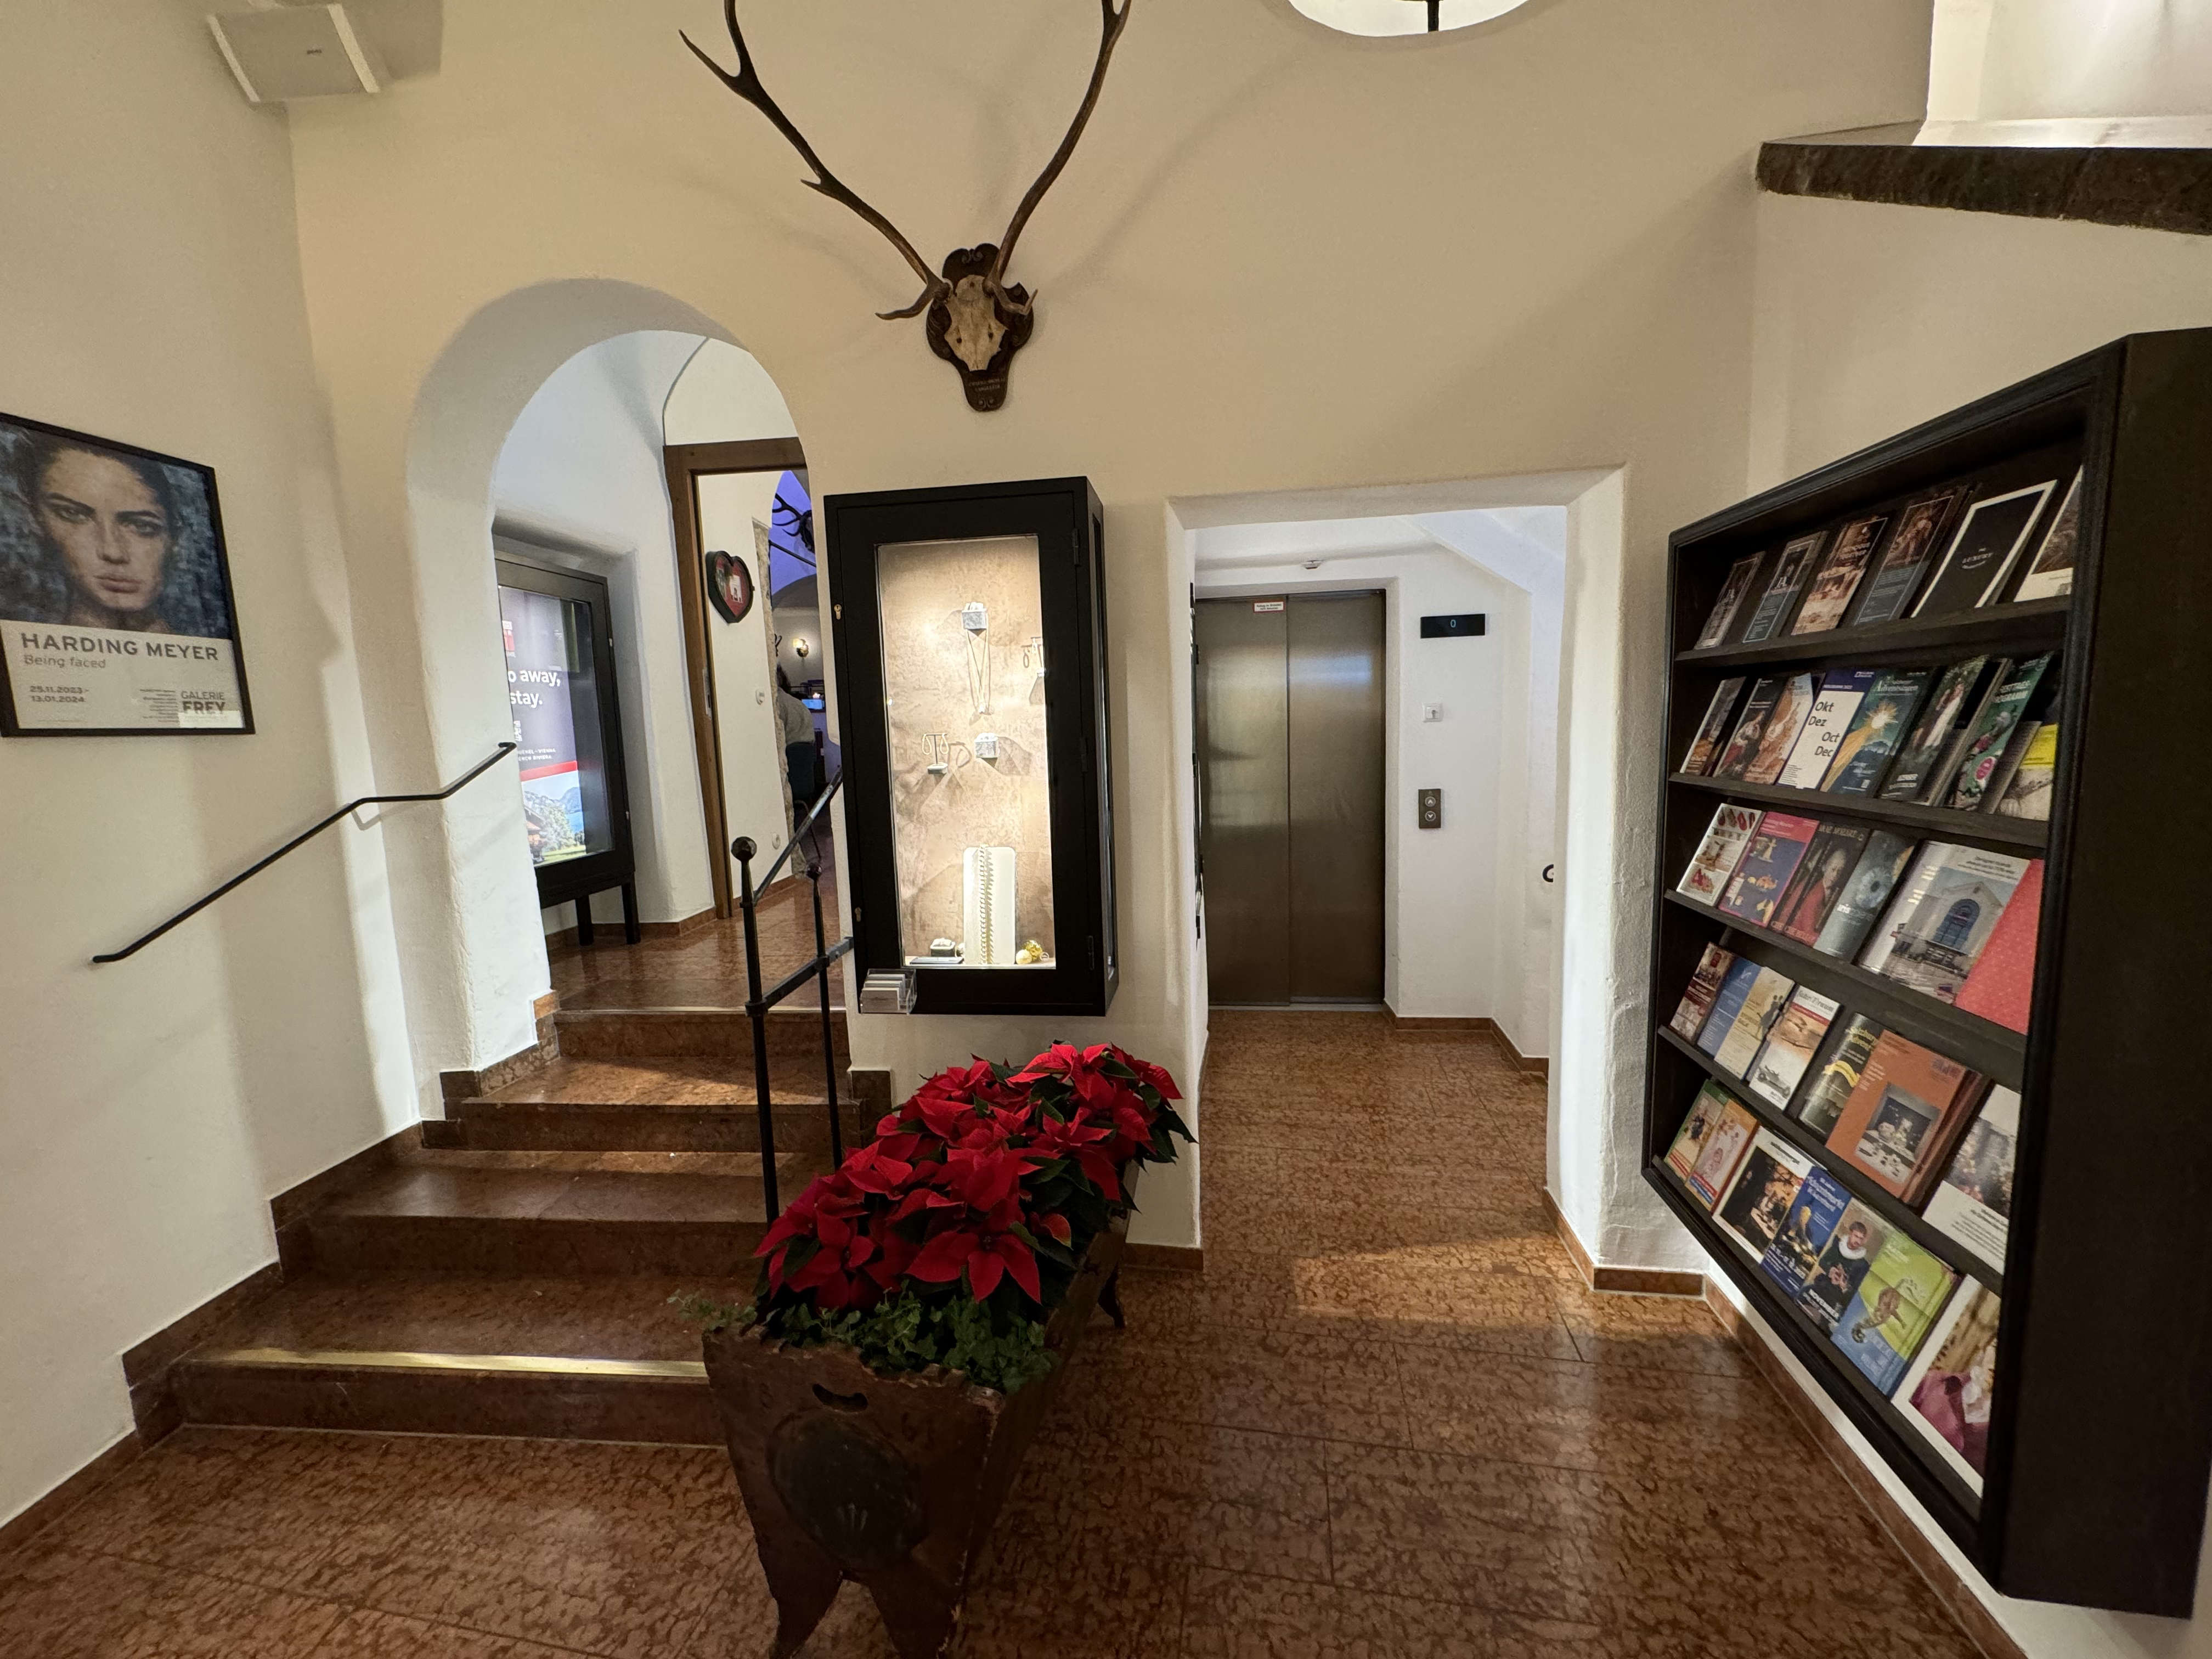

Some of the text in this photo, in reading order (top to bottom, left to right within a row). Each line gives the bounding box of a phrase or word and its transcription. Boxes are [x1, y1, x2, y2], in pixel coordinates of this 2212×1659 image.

[1450, 619, 1456, 628] 0
[21, 633, 218, 661] HARDING MEYER
[24, 654, 106, 668] Being faced
[520, 670, 561, 687] away,
[31, 695, 86, 703] 13.01.2024
[180, 691, 225, 701] GALERIE
[510, 690, 543, 708] stay.
[182, 701, 225, 715] FREY
[1815, 701, 1835, 713] Okt
[1808, 715, 1827, 727] Dez
[1821, 731, 1840, 743] Oct
[1814, 746, 1834, 757] Dec
